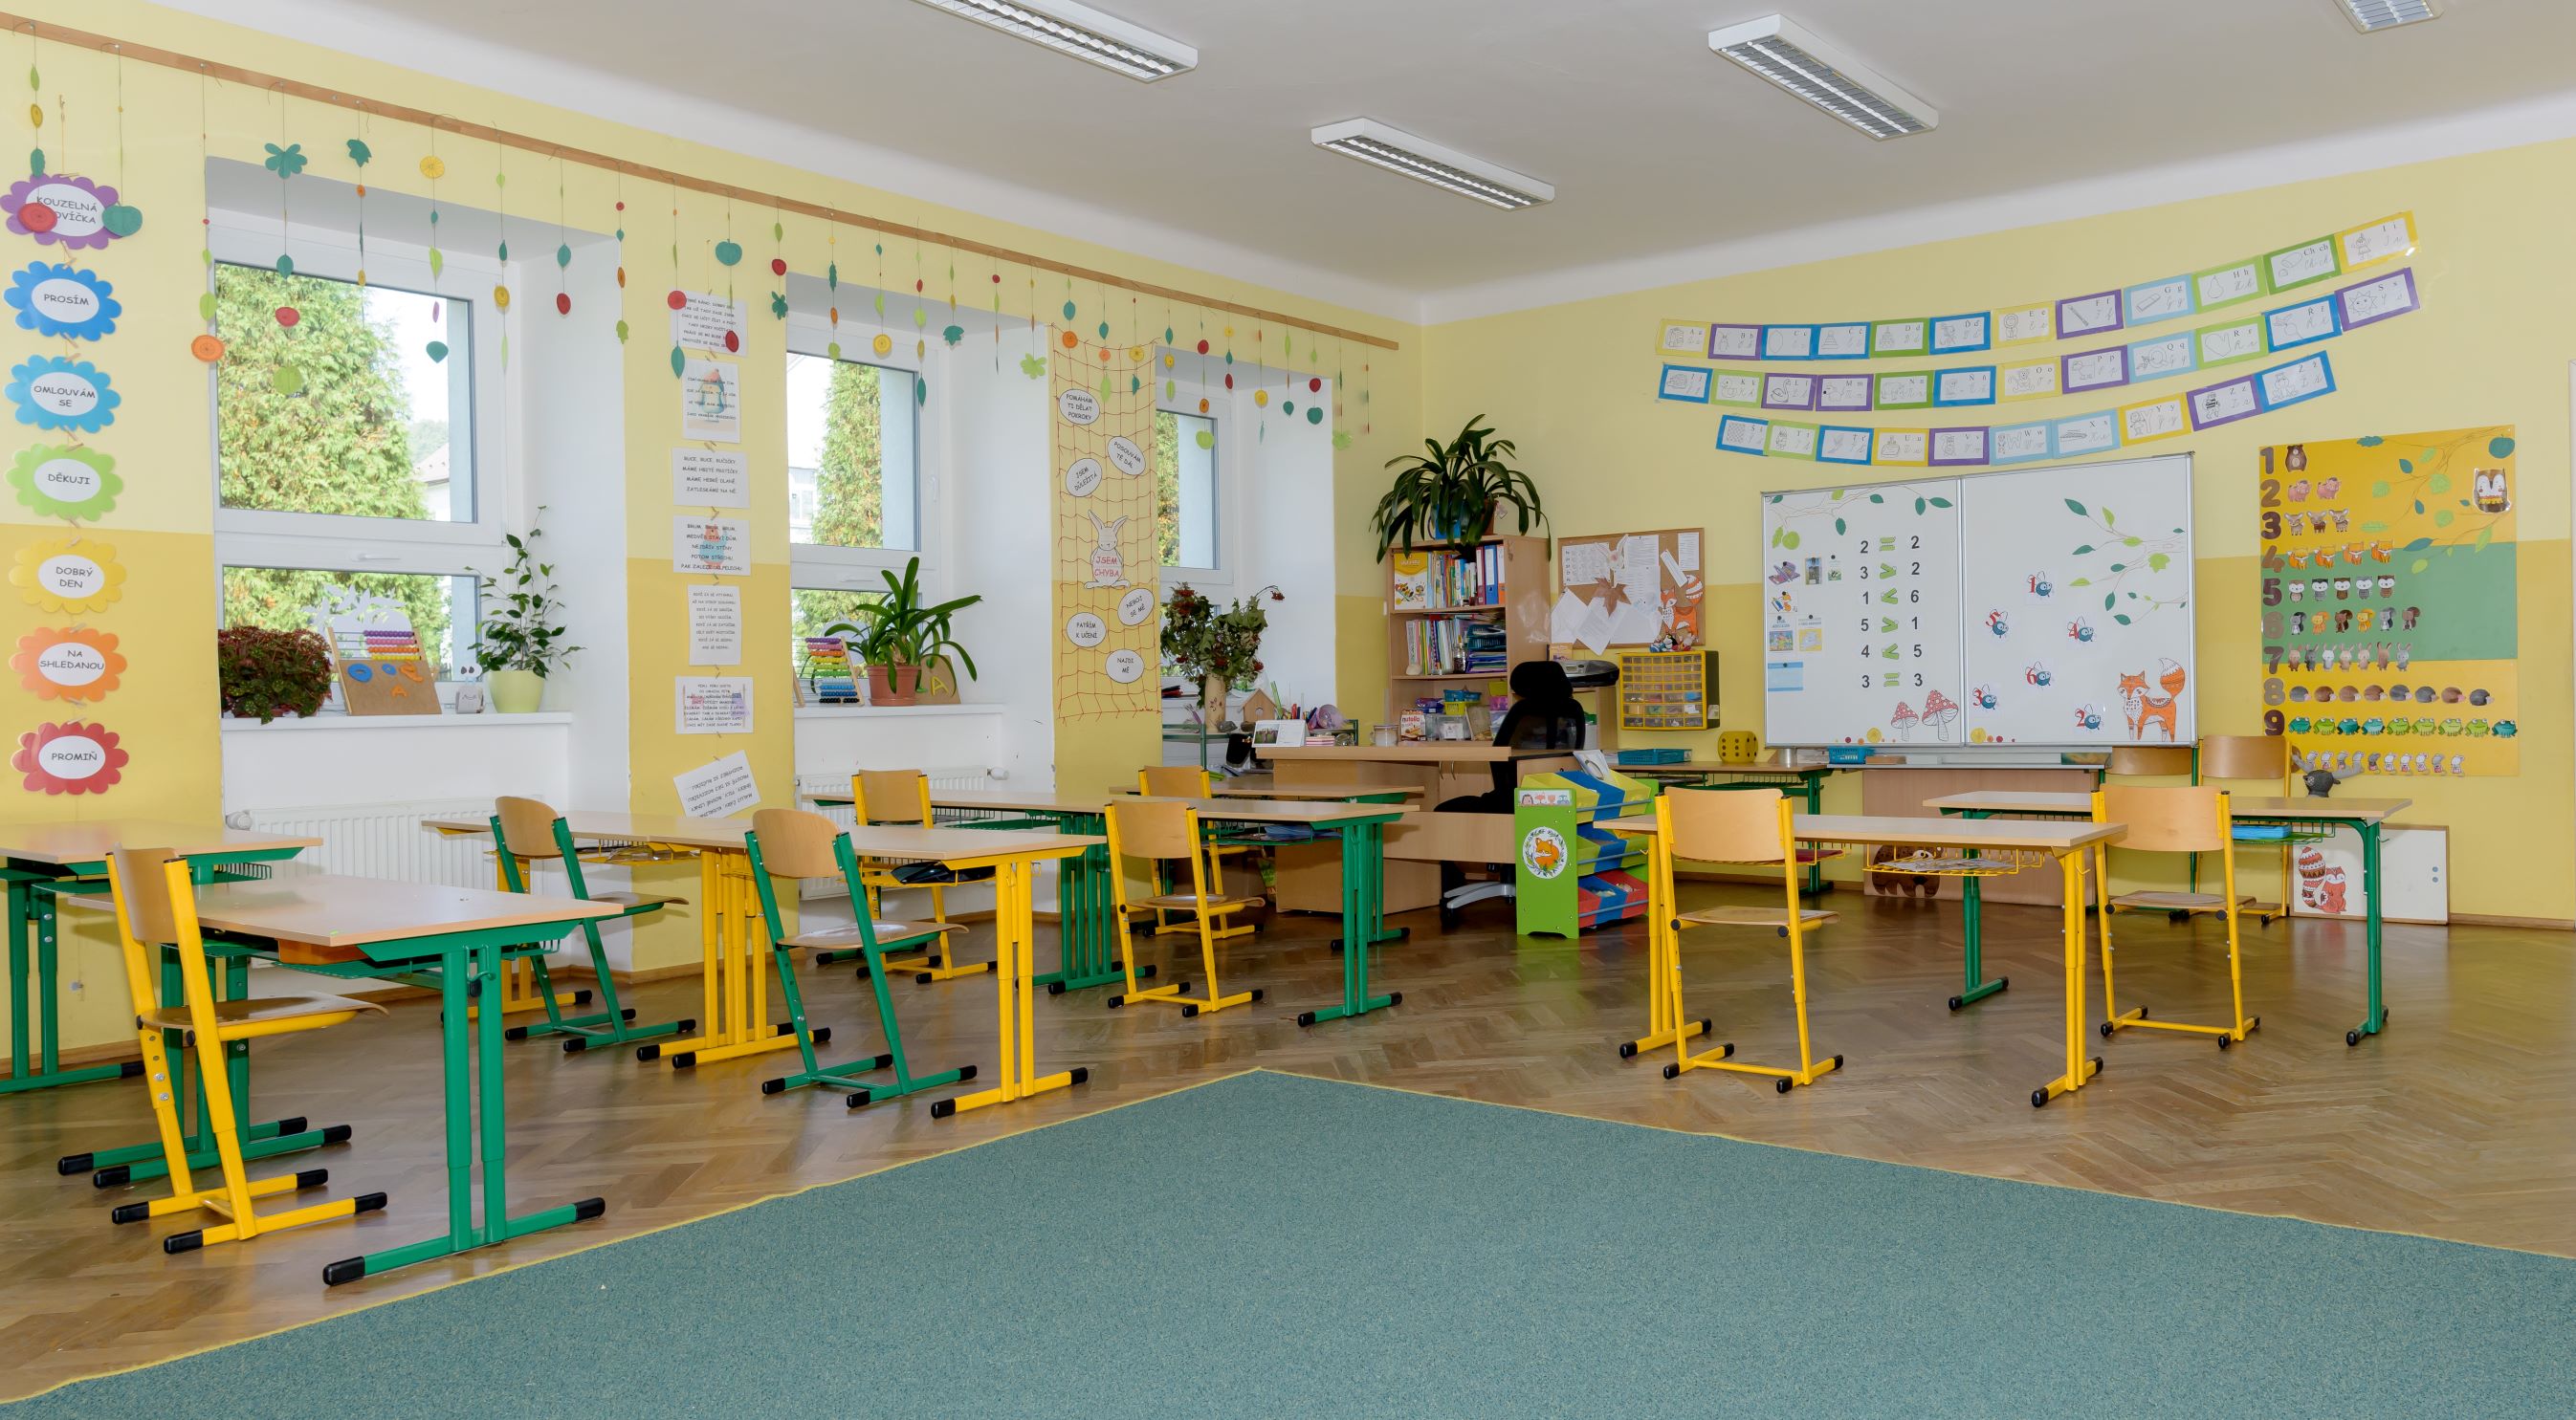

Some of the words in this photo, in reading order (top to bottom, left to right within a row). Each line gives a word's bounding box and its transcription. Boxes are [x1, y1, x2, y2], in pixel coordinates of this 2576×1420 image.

[37, 196, 97, 212] KOUZELNÁ
[56, 212, 96, 224] OVÍČKA
[2304, 247, 2315, 256] Ch
[44, 294, 89, 305] PROSÍM
[33, 385, 95, 398] OMLOUVÁM
[1066, 393, 1092, 404] POMÁHÁM
[1076, 403, 1092, 412] DĚLAT
[1068, 412, 1092, 420] POKROKY
[2260, 447, 2274, 474] 1
[48, 472, 91, 485] DĚKUJI
[1075, 466, 1088, 478] JSEM
[2260, 479, 2281, 508] 2
[2261, 511, 2281, 540] 3
[1860, 541, 1869, 554] 2
[1911, 535, 1920, 549] 2
[1095, 557, 1117, 565] JSEM
[2261, 545, 2285, 573] 4
[56, 566, 93, 577] DOBRÝ
[1860, 566, 1868, 579] 3
[1912, 562, 1920, 575] 2
[60, 579, 83, 588] DEN
[2028, 577, 2036, 593] 1
[1862, 592, 1868, 605] 1
[1911, 590, 1920, 603] 6
[2263, 578, 2282, 607] 5
[1861, 618, 1869, 631] 5
[1912, 617, 1918, 630] 1
[2068, 623, 2079, 639] 4
[2263, 611, 2284, 639] 6
[1861, 645, 1870, 658] 4
[1913, 644, 1922, 658] 5
[39, 661, 104, 670] SHLEDANOU
[2264, 646, 2284, 675] 7
[1862, 675, 1870, 688] 3
[1914, 673, 1923, 687] 3
[2026, 667, 2037, 685] 6
[930, 676, 949, 696] A
[2264, 678, 2285, 706] 8
[1973, 689, 1983, 706] 3
[2075, 708, 2085, 727] 2
[2264, 709, 2285, 736] 9
[51, 751, 97, 761] PROMIŇ
